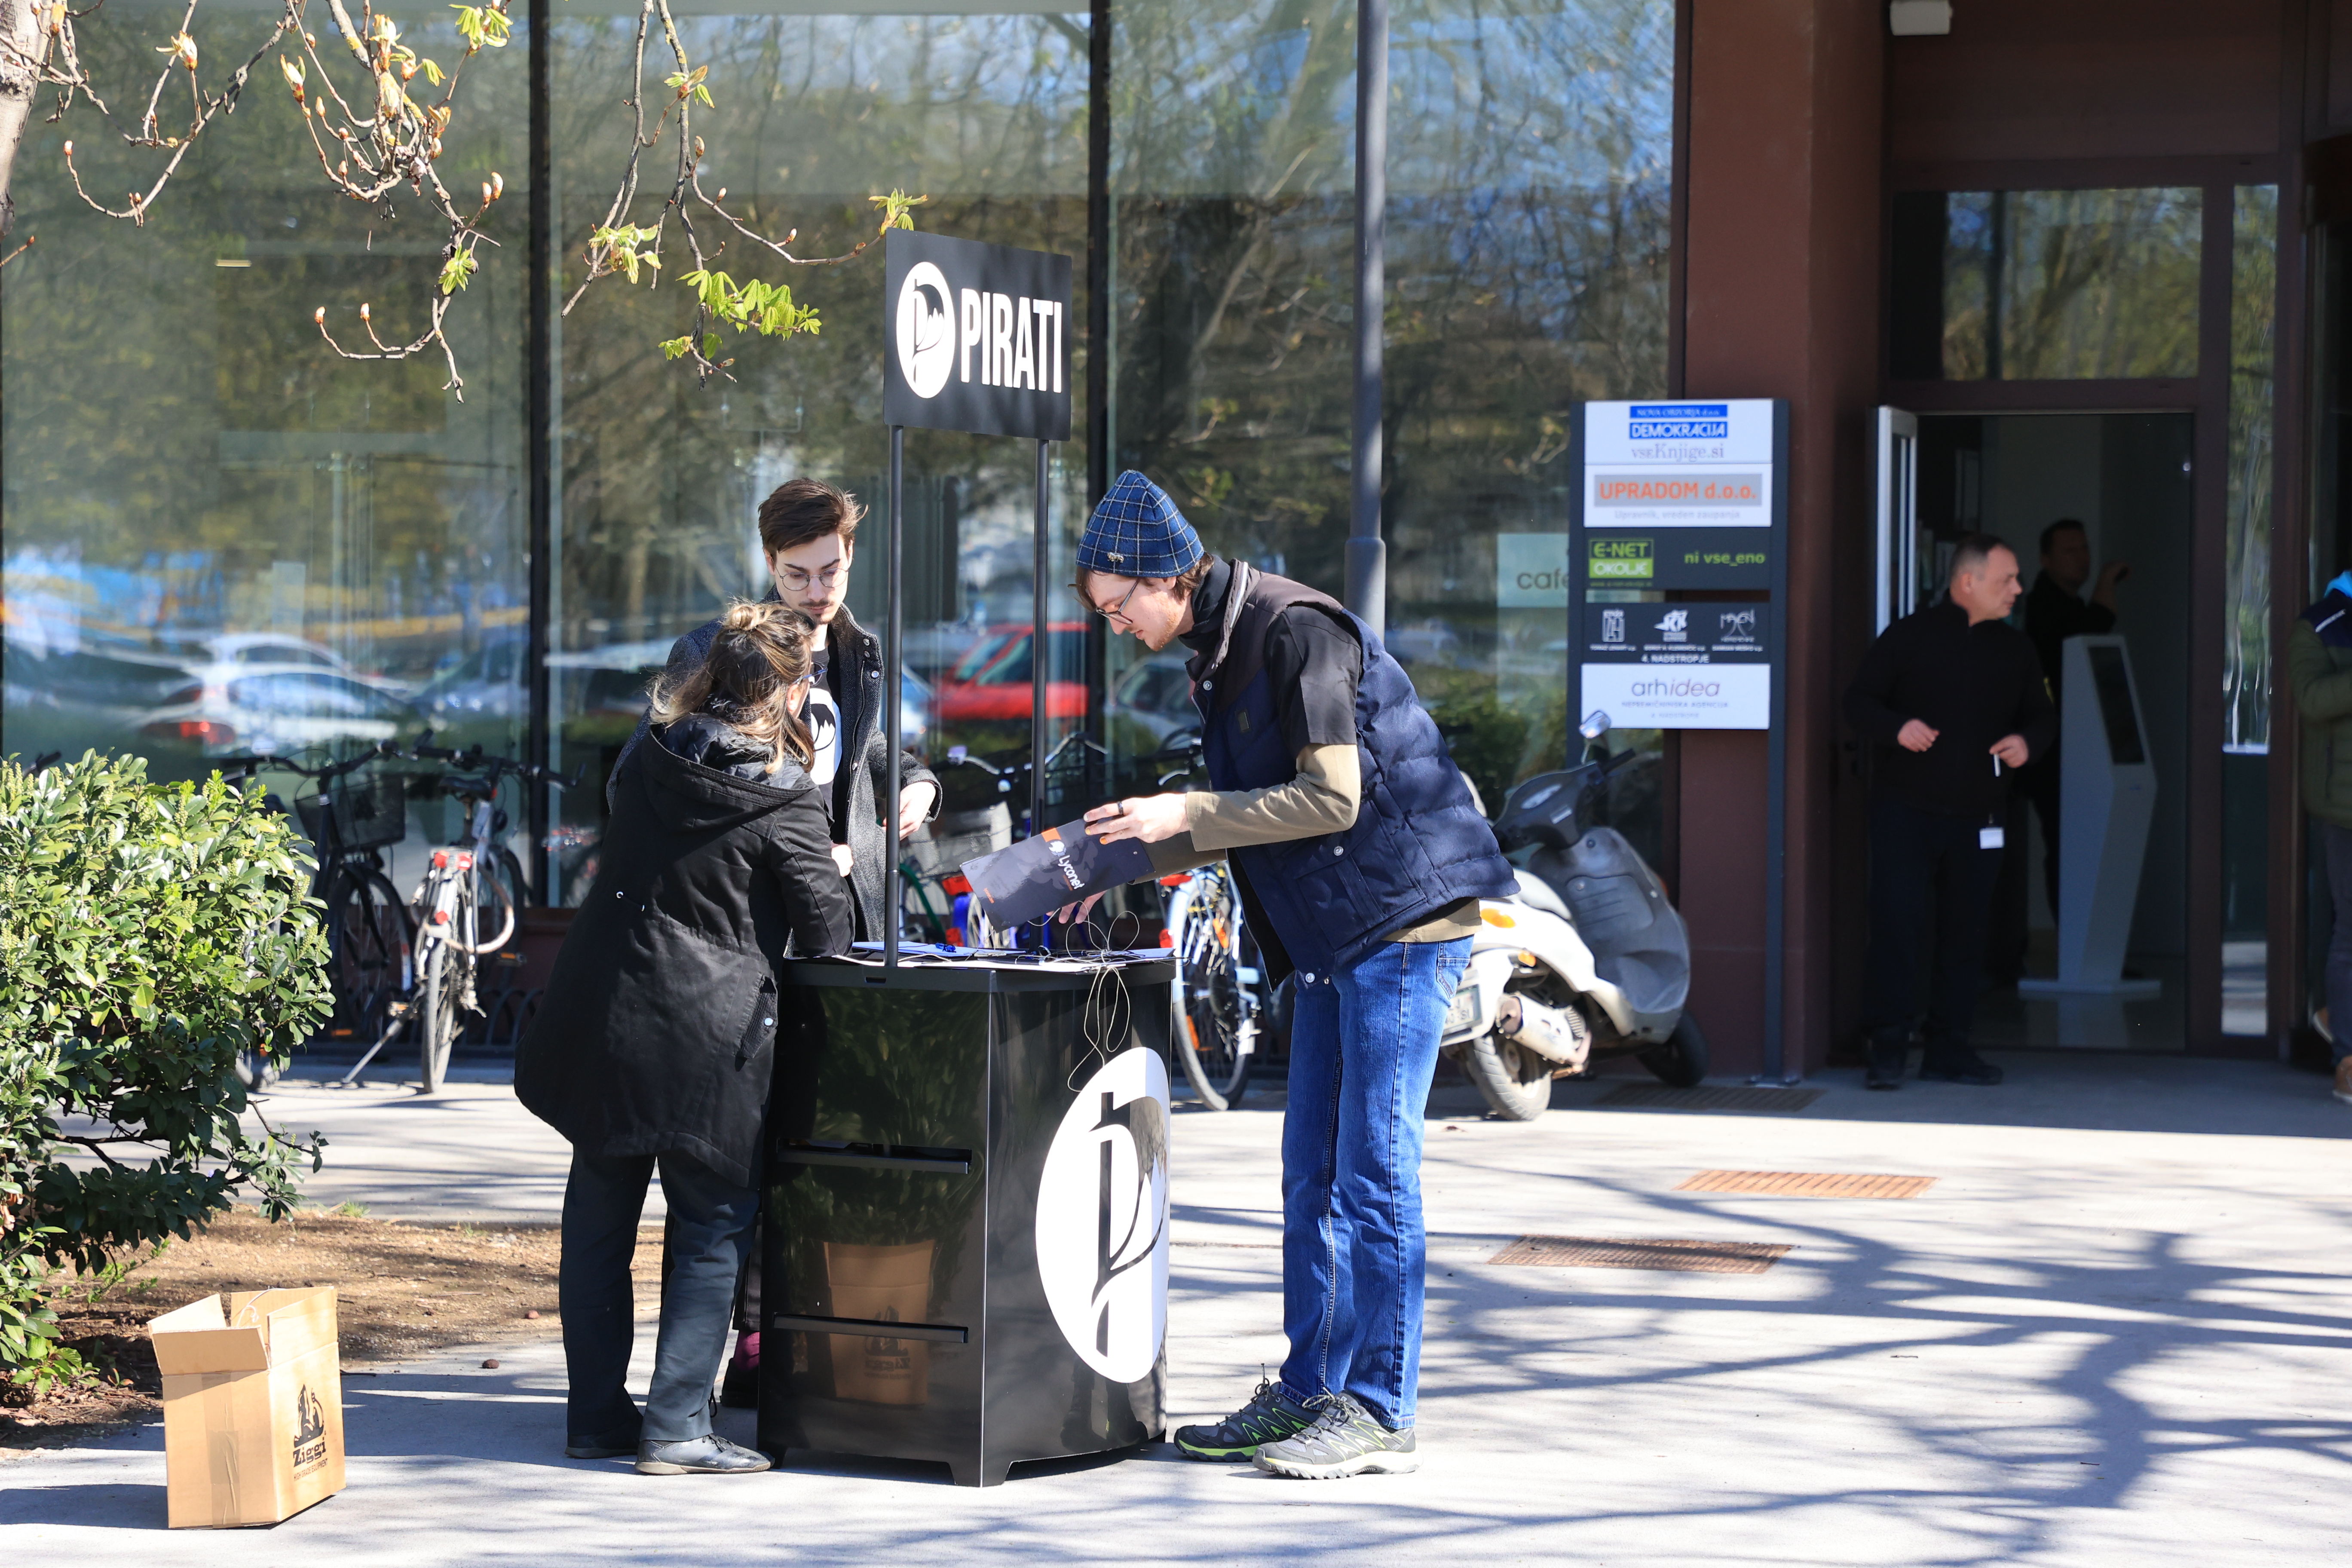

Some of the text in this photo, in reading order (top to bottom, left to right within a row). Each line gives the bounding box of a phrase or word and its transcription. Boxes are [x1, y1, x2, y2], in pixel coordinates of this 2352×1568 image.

[961, 288, 1062, 393] PIRATI
[1632, 422, 1725, 438] DEMOKRACIJA
[1600, 482, 1756, 499] UPRADOM d.o.o.
[1594, 542, 1648, 558] E-NET
[1684, 551, 1765, 567] ni vse_eno
[1651, 653, 1710, 663] NADSTROPJE
[1632, 678, 1721, 697] arhidea
[1058, 855, 1085, 889] Lyconet
[293, 1436, 326, 1467] Ziggi
